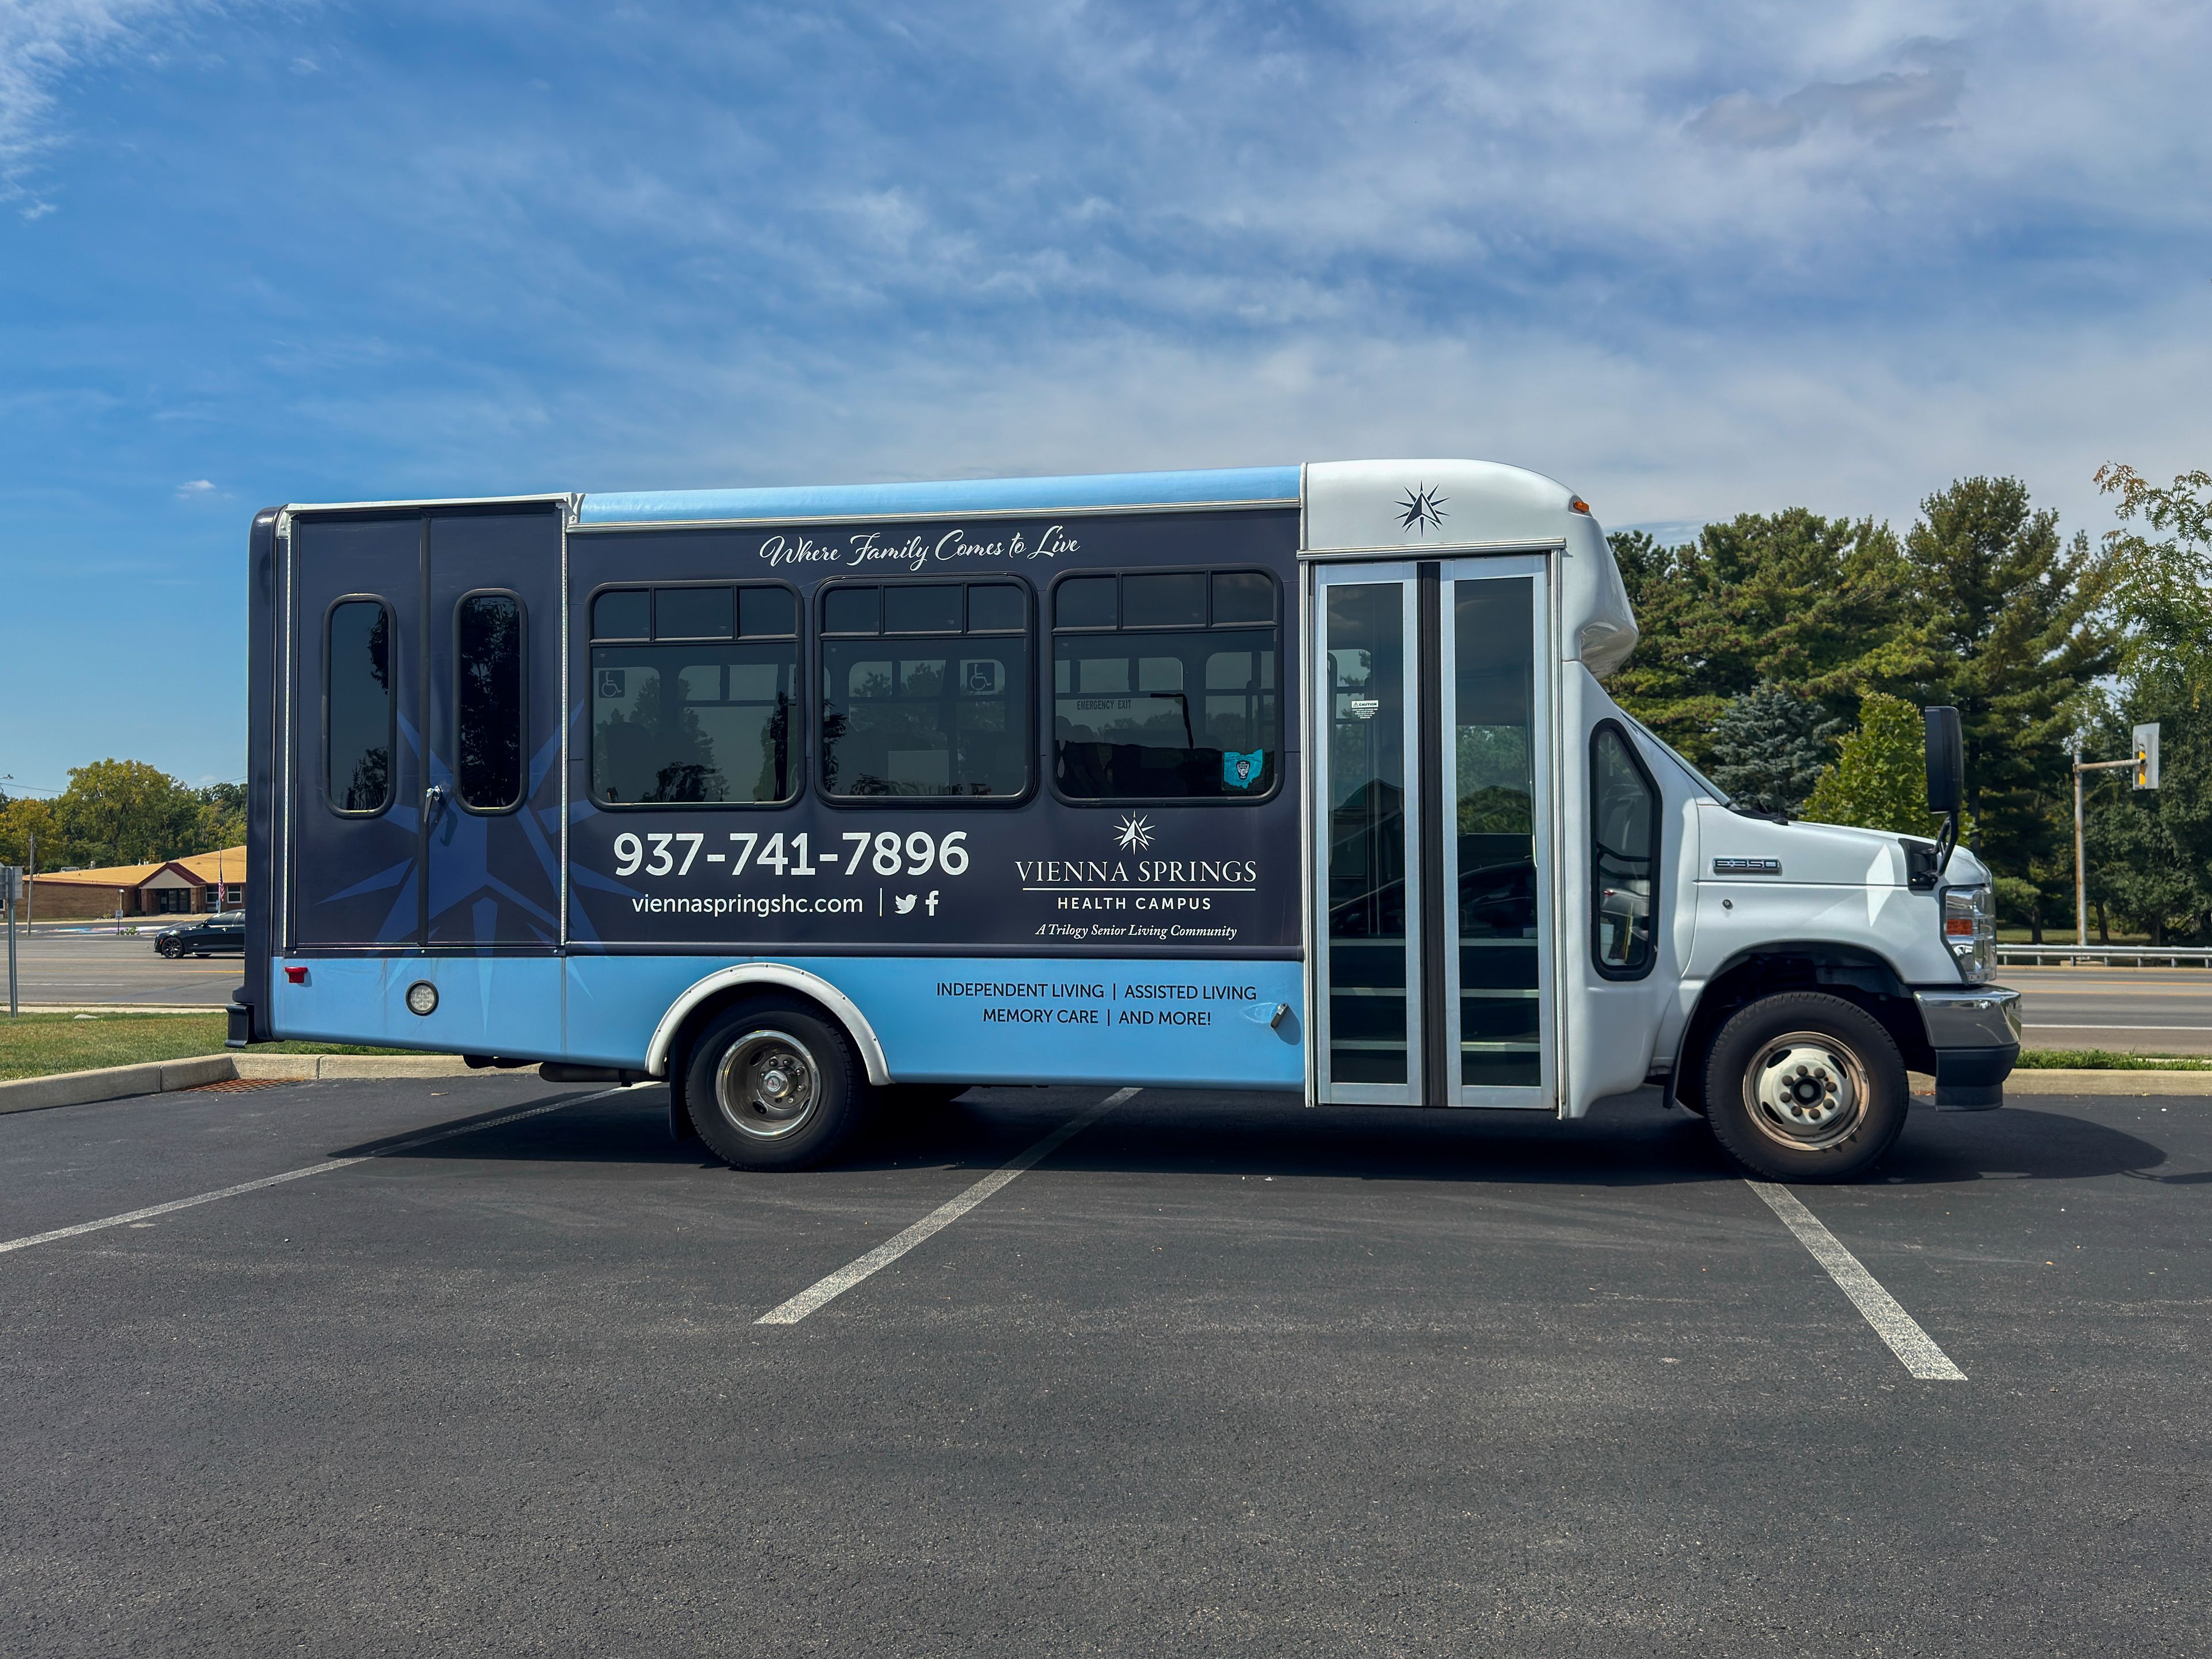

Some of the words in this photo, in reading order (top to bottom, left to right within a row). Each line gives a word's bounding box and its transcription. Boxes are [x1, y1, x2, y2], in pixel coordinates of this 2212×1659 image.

[759, 536, 841, 567] Where
[846, 532, 930, 571] Family
[935, 529, 1005, 561] Comes
[1009, 532, 1027, 559] to
[1027, 525, 1081, 560] Live
[1077, 700, 1114, 710] EMERGENCY
[1118, 699, 1132, 710] EXIT
[613, 831, 969, 876] 937-741-7896
[1014, 861, 1130, 882] VIENNA
[1138, 861, 1257, 882] SPRINGS
[632, 893, 863, 918] viennaspringshc.com
[1058, 897, 1126, 910] HEALTH
[1135, 897, 1211, 910] CAMPUS
[1035, 923, 1047, 935] A
[1048, 923, 1088, 940] Trilogy
[1090, 924, 1126, 936] Senior
[1127, 924, 1168, 941] Living
[1171, 925, 1237, 941] Community
[937, 982, 1048, 997] INDEPENDENT
[1052, 983, 1104, 998] LIVING
[1124, 984, 1198, 999] ASSISTED
[1202, 986, 1256, 1000] LIVING
[983, 1008, 1054, 1023] MEMORY
[1056, 1009, 1099, 1024] CARE
[1118, 1010, 1154, 1025] AND
[1158, 1011, 1211, 1026] MORE!
